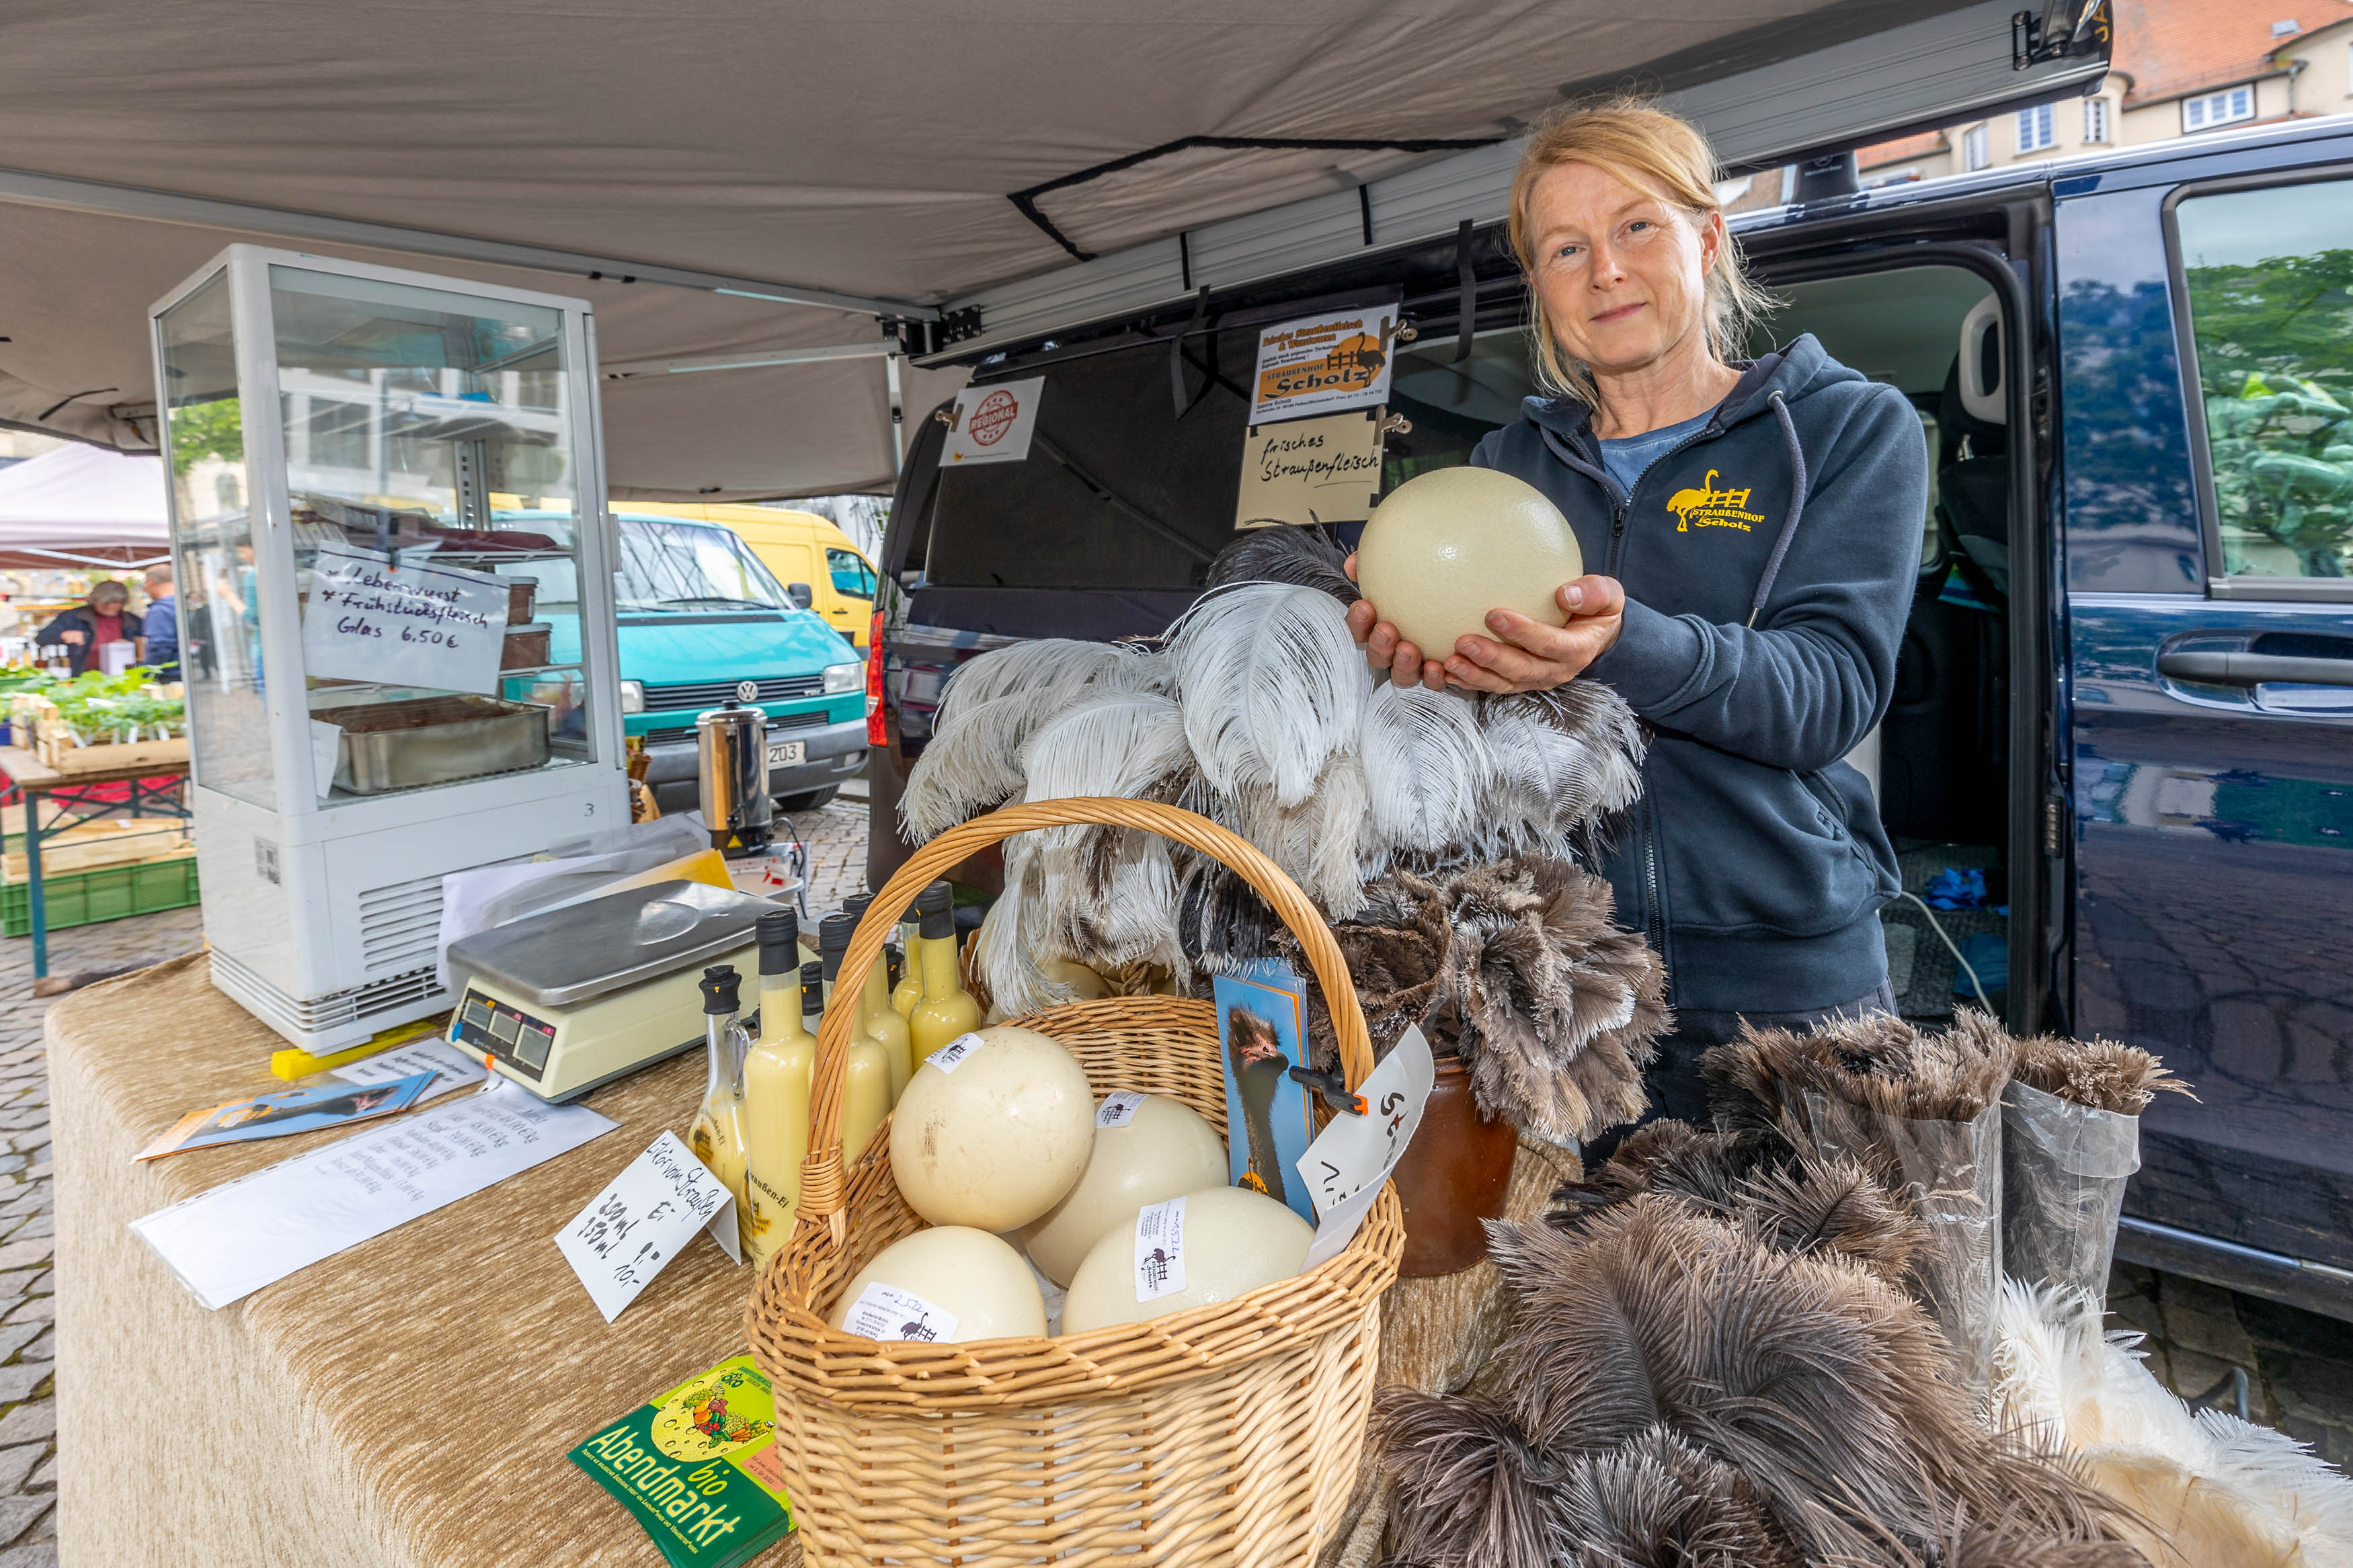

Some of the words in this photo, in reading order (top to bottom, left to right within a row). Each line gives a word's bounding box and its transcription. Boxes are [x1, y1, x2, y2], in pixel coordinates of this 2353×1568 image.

[1264, 368, 1367, 399] Scholz
[971, 406, 1015, 429] REGIONAL
[1261, 432, 1324, 465] frisches
[1261, 449, 1378, 483] Straußenfleisch
[1692, 508, 1765, 523] STRAUßENHOF
[1695, 518, 1751, 532] Scholz
[337, 616, 383, 637] Glas
[769, 745, 797, 763] 203
[646, 1137, 673, 1167] Likör
[662, 1164, 683, 1180] vom
[647, 1201, 675, 1222] Ei
[588, 1426, 741, 1547] Abendmarkt
[687, 1460, 729, 1495] bio
